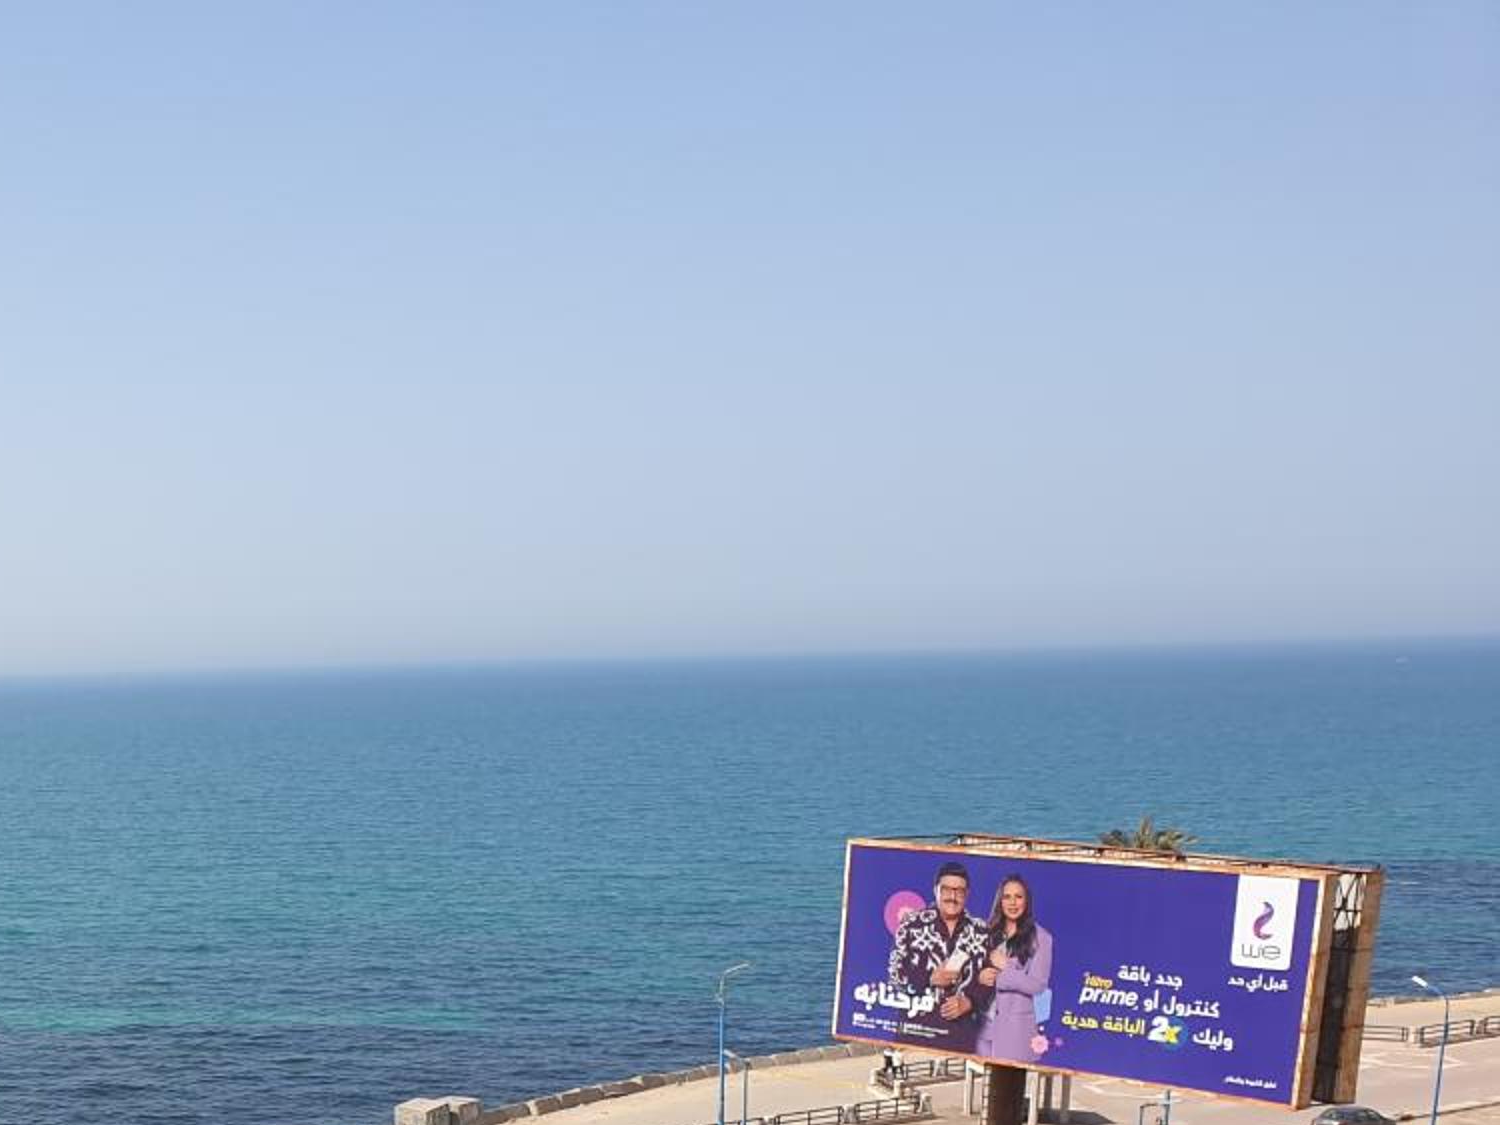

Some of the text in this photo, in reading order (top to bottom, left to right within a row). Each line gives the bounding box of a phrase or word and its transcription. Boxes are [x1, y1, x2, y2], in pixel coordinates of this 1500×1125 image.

[1117, 965, 1150, 987] باقة
[1155, 975, 1183, 991] جدد
[1227, 976, 1245, 987] حد
[1263, 975, 1289, 992] قبل
[1143, 989, 1159, 1012] أو
[1162, 996, 1220, 1018] كنترول
[1061, 1010, 1098, 1031] هدية
[1102, 1015, 1145, 1038] الباقة
[1192, 1027, 1233, 1051] وليك
